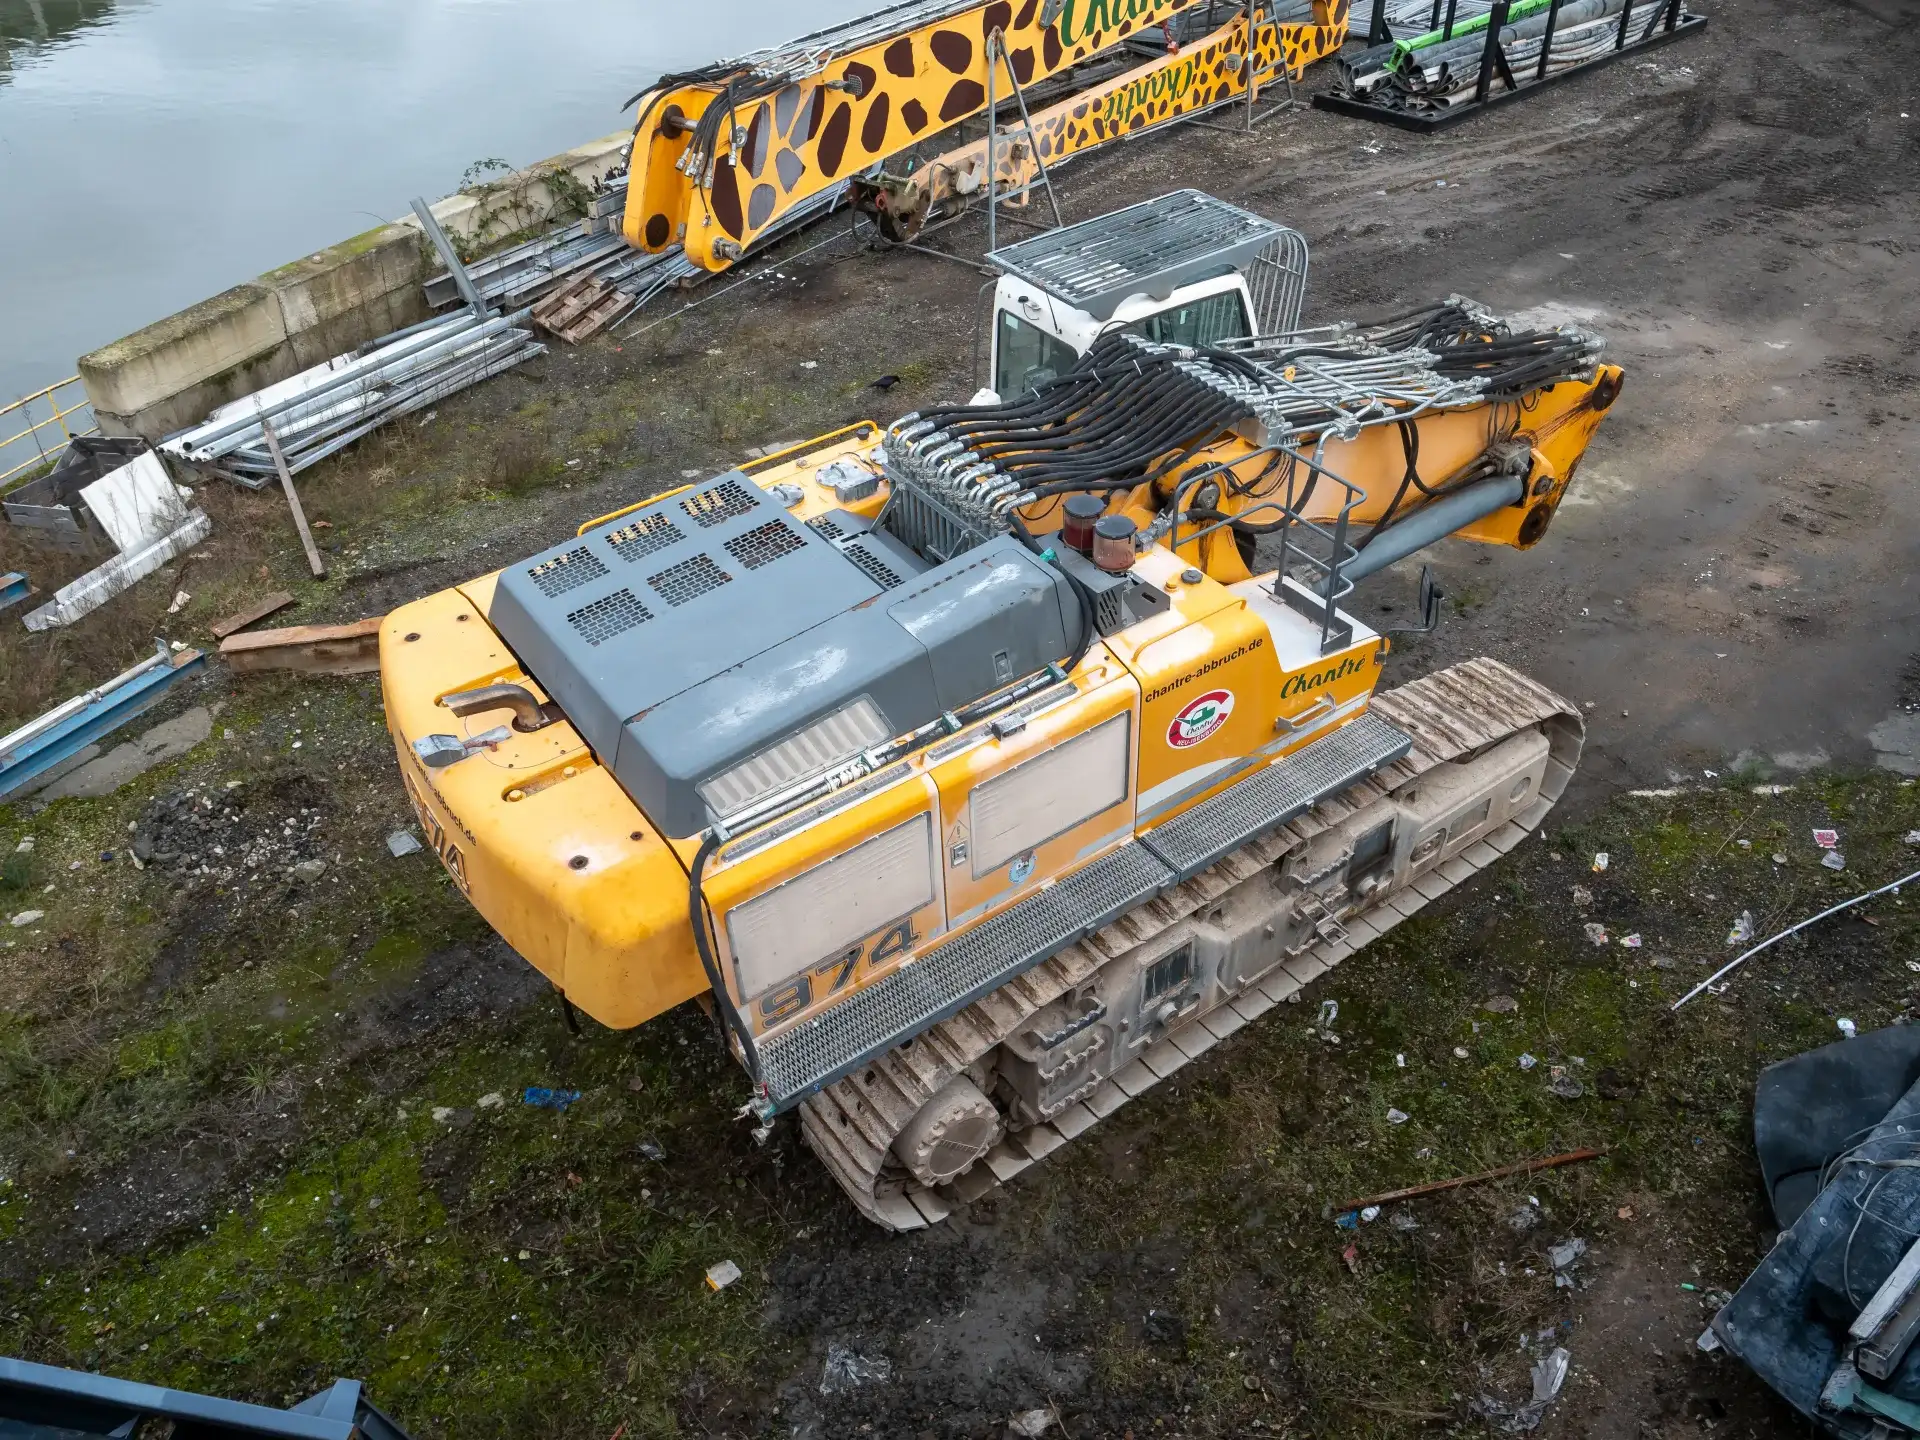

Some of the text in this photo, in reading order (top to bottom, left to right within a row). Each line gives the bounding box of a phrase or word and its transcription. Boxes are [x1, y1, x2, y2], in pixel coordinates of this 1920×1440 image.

[1103, 61, 1192, 129] Chantré
[1145, 637, 1263, 703] chantre-abbruch.de
[1280, 654, 1367, 699] Chantré
[759, 917, 922, 1030] 974
